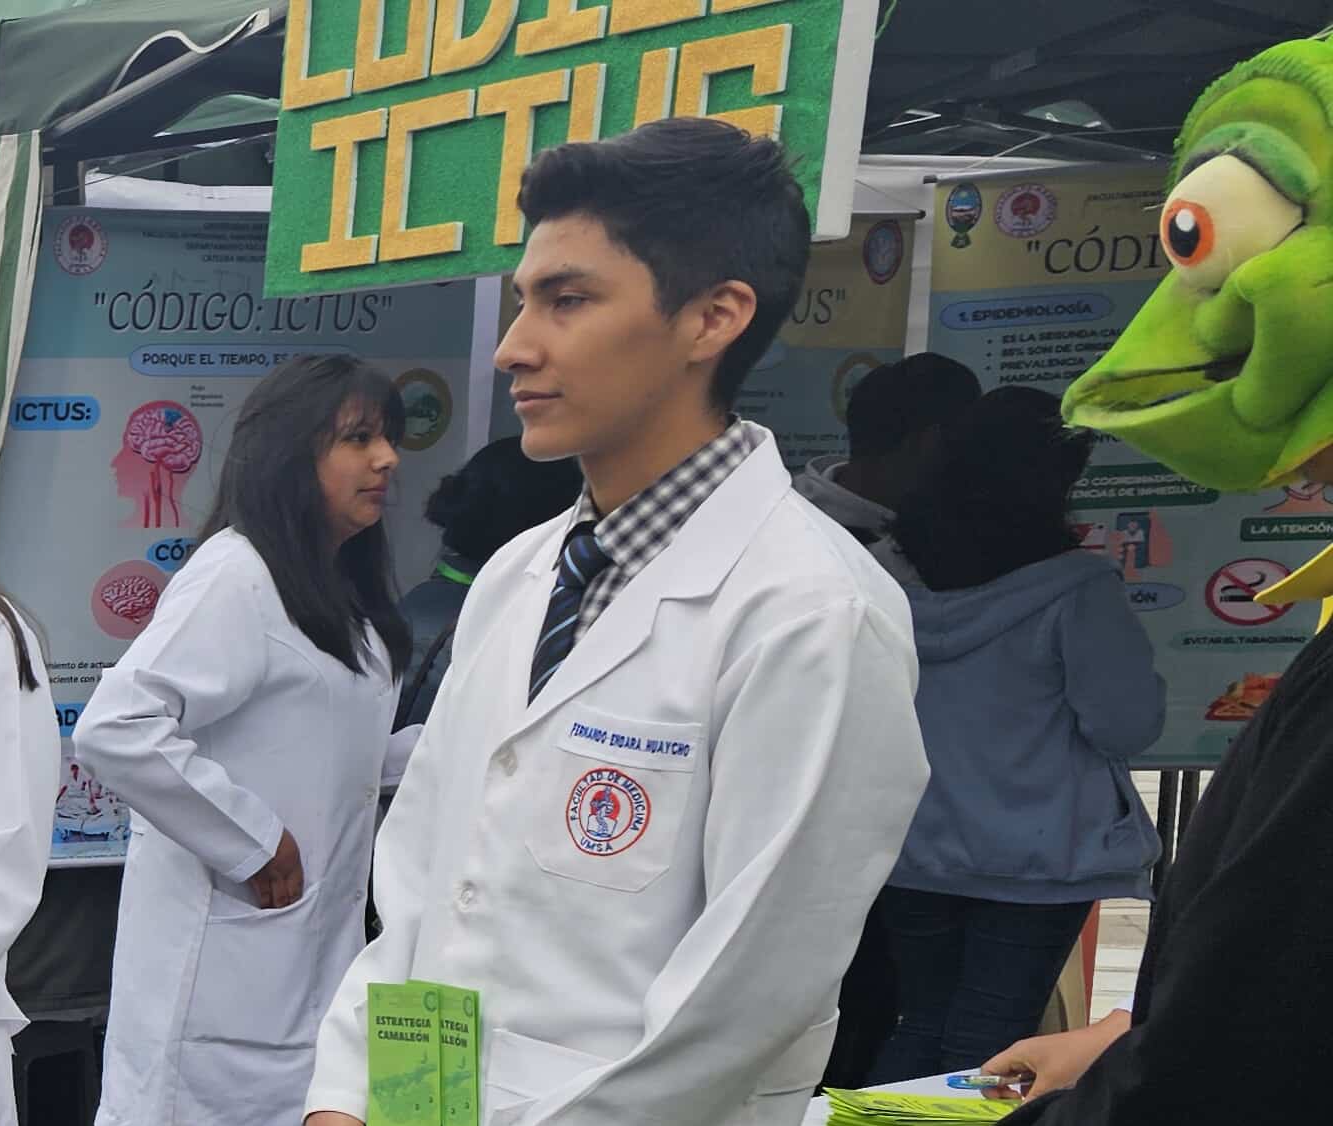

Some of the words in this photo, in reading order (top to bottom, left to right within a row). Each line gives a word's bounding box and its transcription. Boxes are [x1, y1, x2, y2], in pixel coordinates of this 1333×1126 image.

[1027, 226, 1168, 275] "CÓDI
[972, 301, 1092, 322] EPIDEMIOLOGÍA
[142, 353, 196, 367] PORQUE
[200, 353, 214, 366] EL
[218, 353, 270, 368] TIEMPO,
[14, 401, 92, 423] ICTUS:
[1251, 525, 1271, 534] LA
[570, 721, 608, 744] FERNANDO
[570, 771, 604, 821] FACULTAD
[607, 770, 622, 784] DE
[622, 778, 646, 832] MEDICINA
[580, 835, 614, 852] UMSA
[375, 1015, 432, 1029] ESTRATEGIA
[440, 1020, 470, 1034] ATEGIA
[378, 1028, 430, 1044] CAMALEÓN
